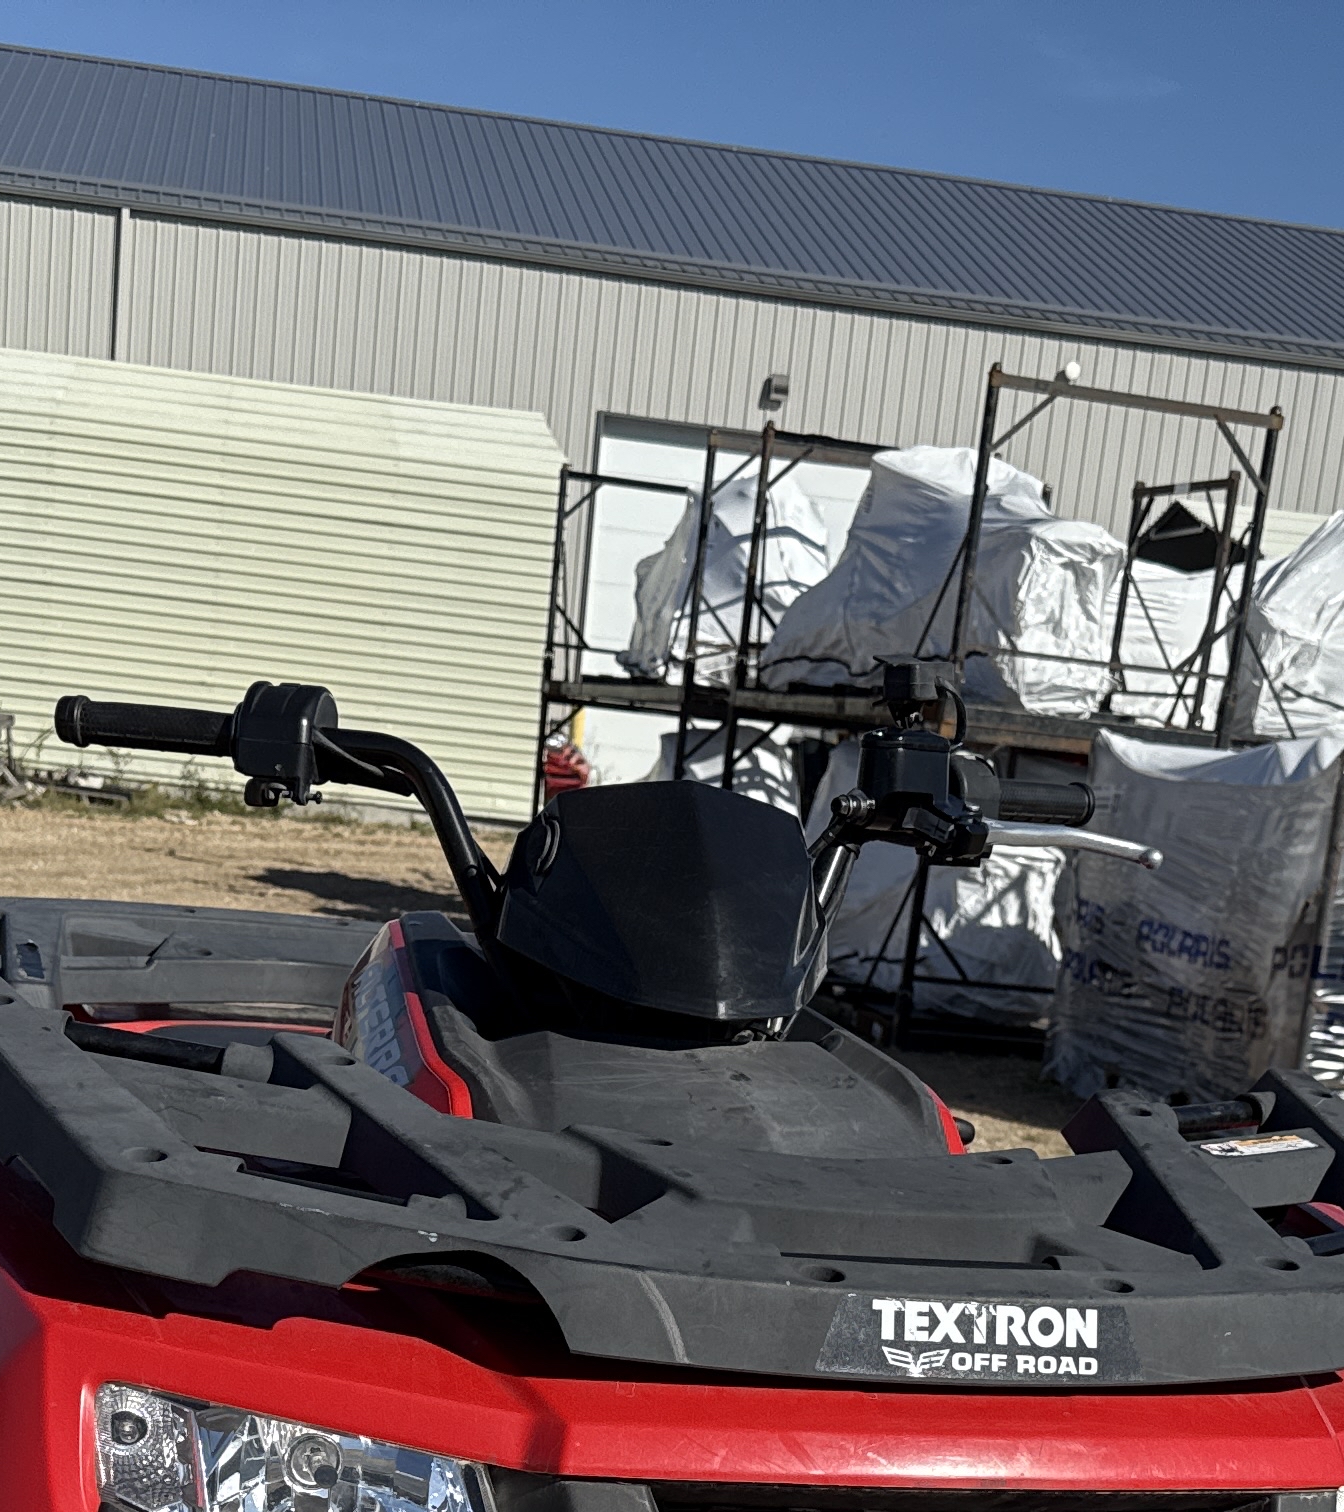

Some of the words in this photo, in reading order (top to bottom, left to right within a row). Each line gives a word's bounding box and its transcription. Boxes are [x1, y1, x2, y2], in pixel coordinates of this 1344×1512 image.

[1136, 918, 1232, 971] POLARIS
[872, 1298, 1098, 1349] TEXTRON
[951, 1352, 1008, 1373] OFF
[1017, 1354, 1099, 1376] ROAD
